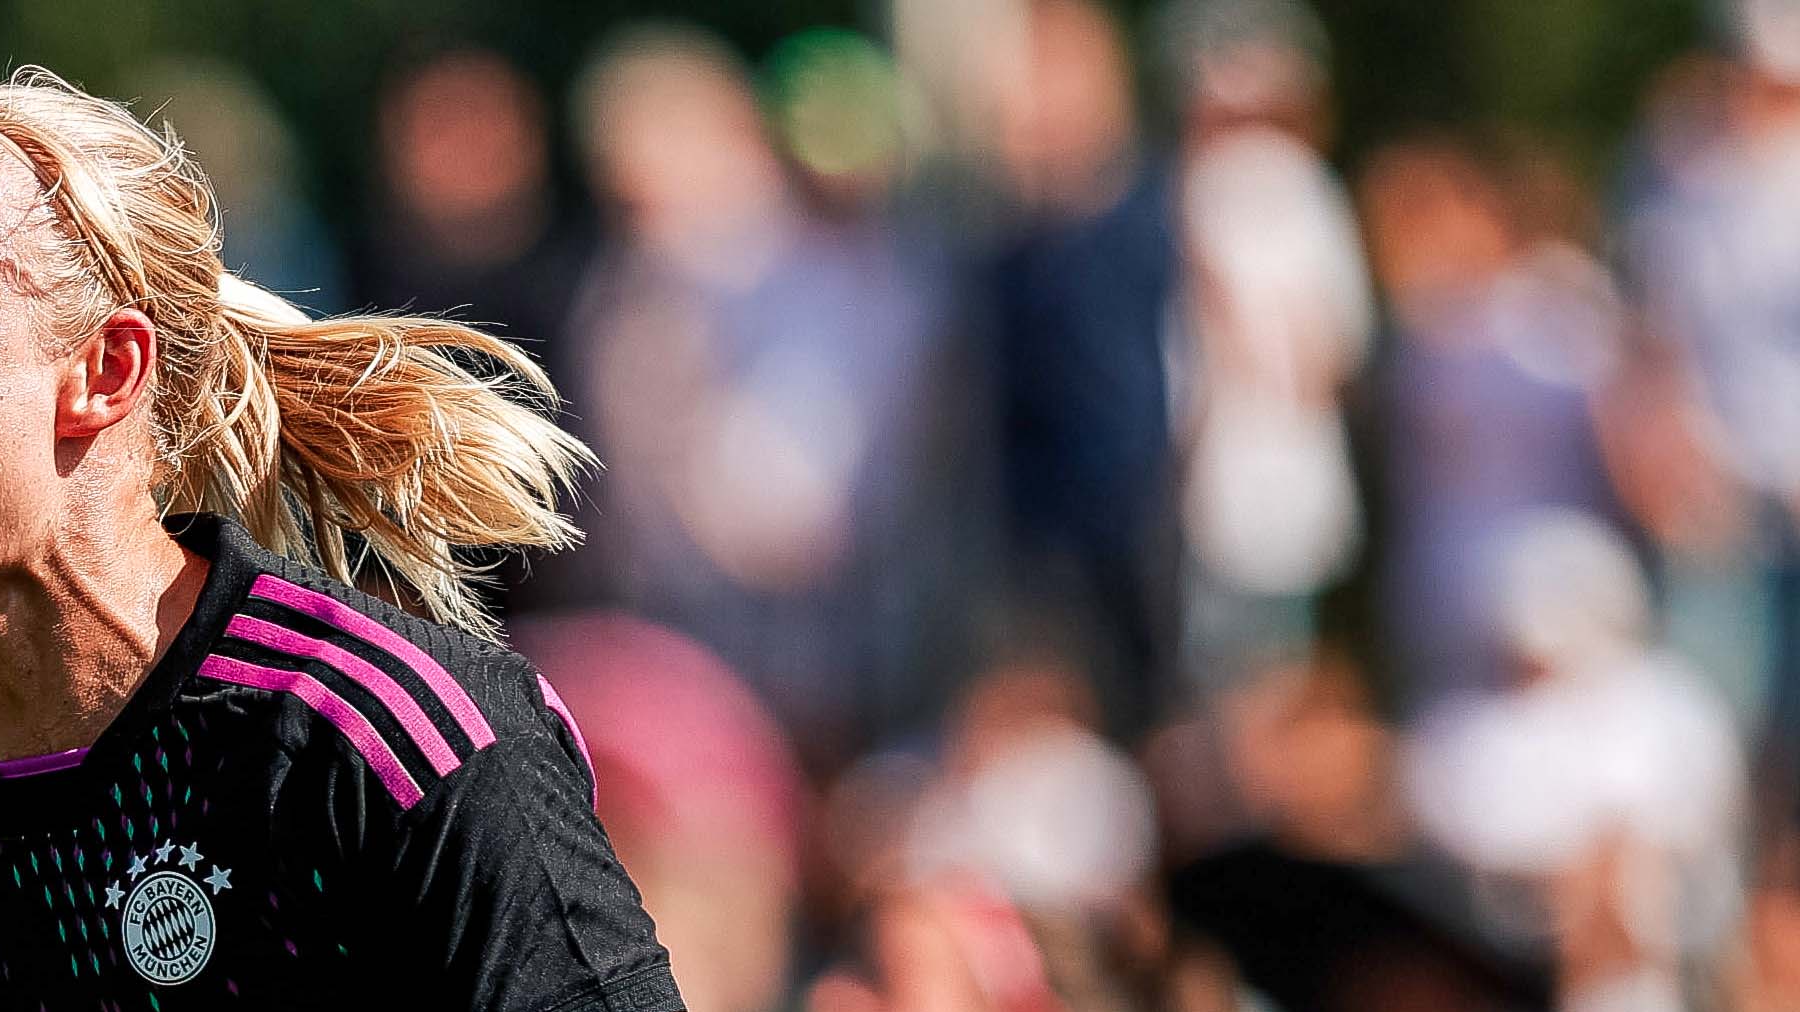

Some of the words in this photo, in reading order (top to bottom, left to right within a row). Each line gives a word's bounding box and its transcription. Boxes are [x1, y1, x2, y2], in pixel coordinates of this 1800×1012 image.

[130, 900, 145, 925] FC
[145, 880, 204, 916] BAYERN
[133, 936, 207, 977] MÜNCHEN
